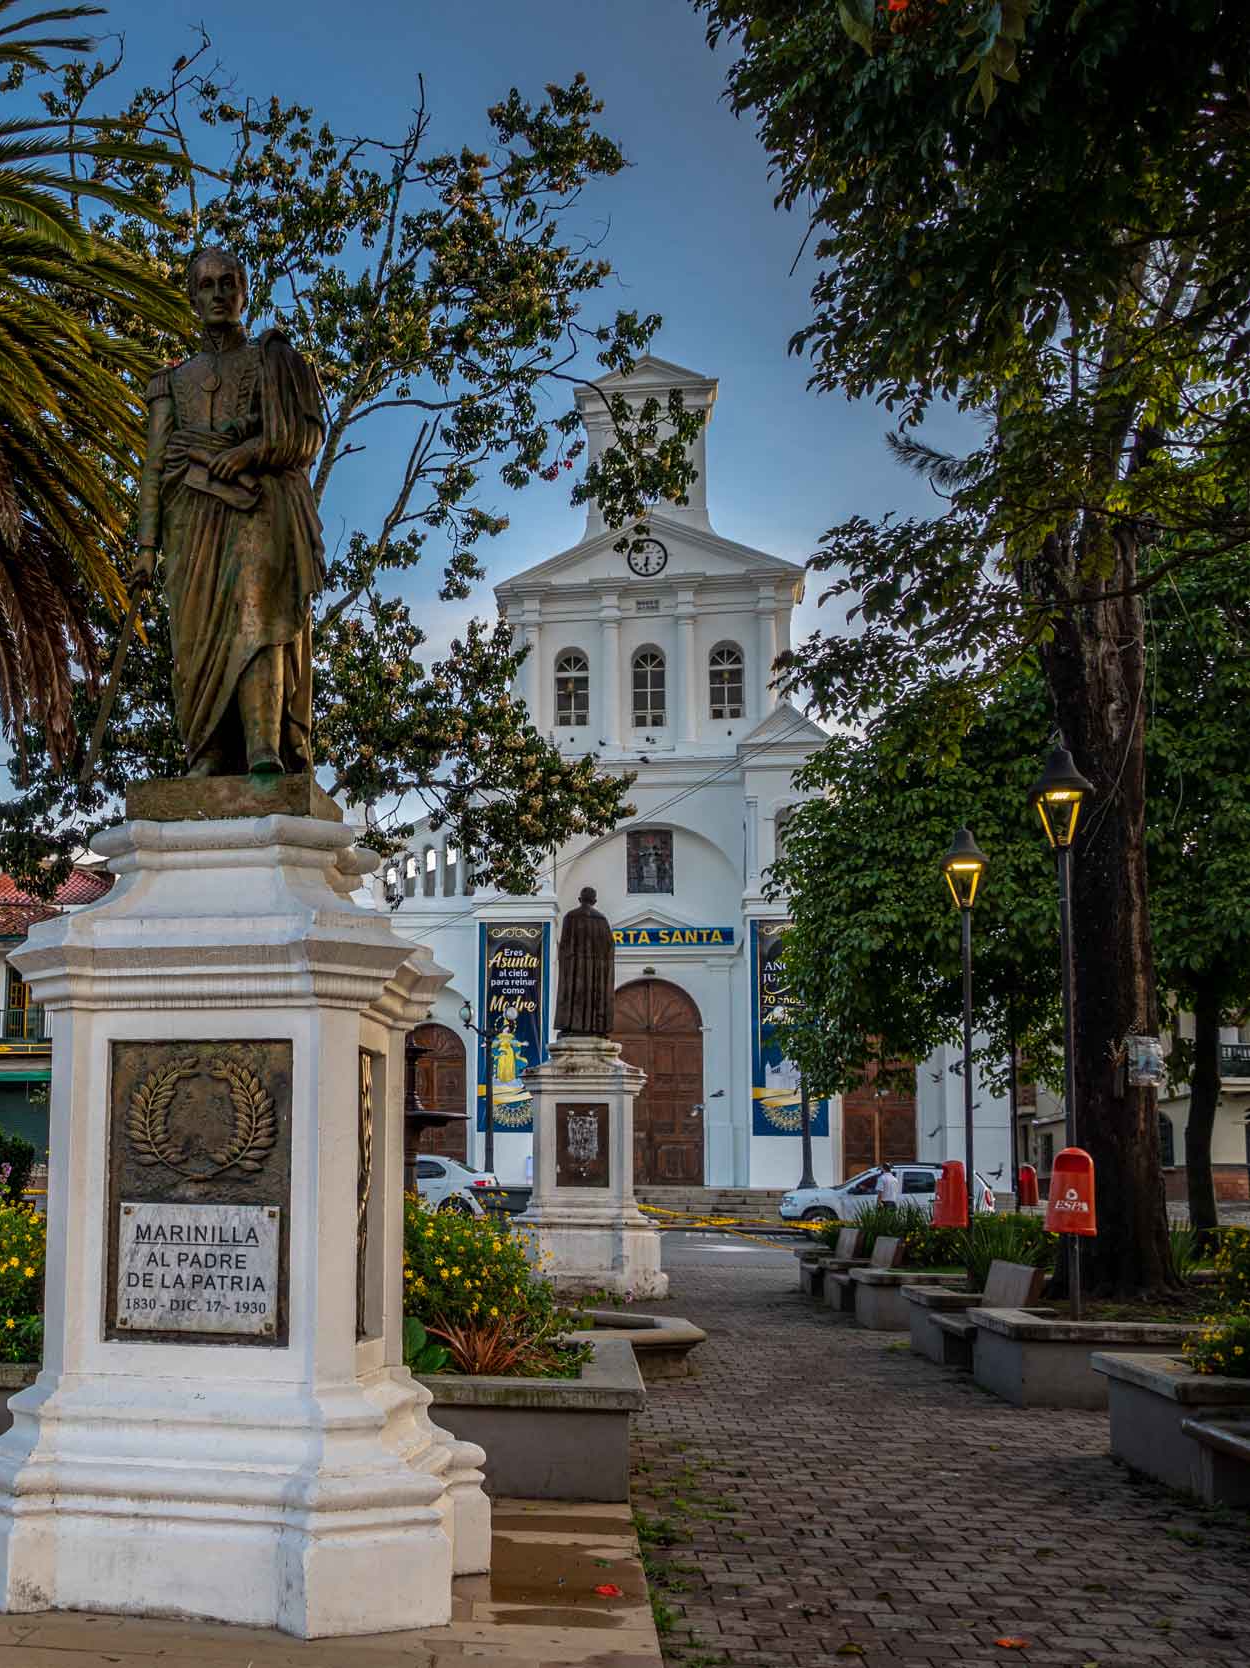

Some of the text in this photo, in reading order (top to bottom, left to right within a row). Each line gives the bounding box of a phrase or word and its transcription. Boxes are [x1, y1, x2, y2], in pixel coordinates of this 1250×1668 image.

[612, 929, 724, 945] RTA SANTA
[488, 951, 540, 969] Asunta
[503, 948, 524, 957] Eres
[498, 968, 529, 977] al cielo
[490, 977, 537, 987] para reinar
[761, 995, 776, 1005] 70
[135, 1223, 260, 1244] MARINILLA
[146, 1251, 248, 1270] AL PADRE
[127, 1272, 266, 1292] DE LA PATRIA
[125, 1297, 157, 1311] 1830
[206, 1299, 222, 1313] 17
[235, 1301, 267, 1314] 1930
